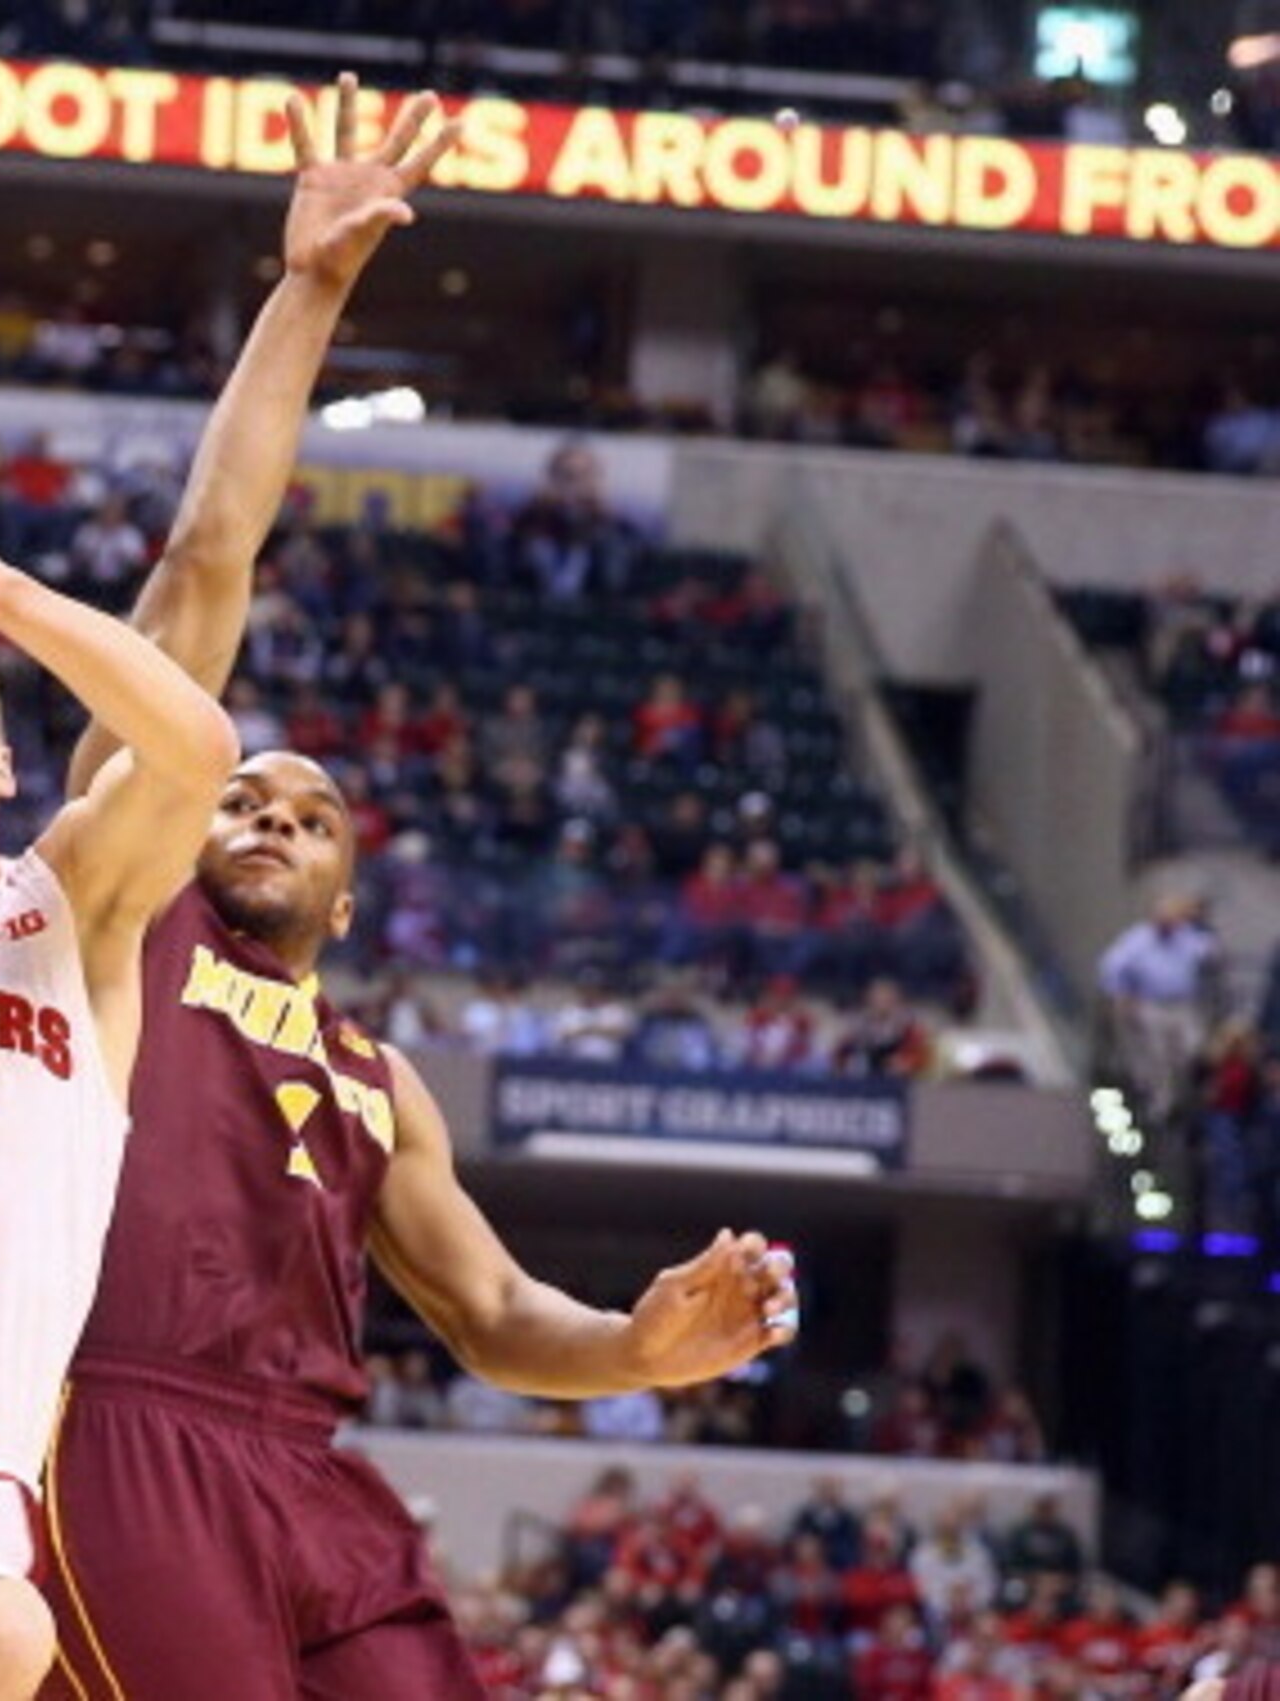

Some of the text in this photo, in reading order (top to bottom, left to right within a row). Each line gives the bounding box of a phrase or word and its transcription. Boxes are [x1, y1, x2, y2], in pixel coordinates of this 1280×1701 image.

[548, 106, 1037, 229] AROUND
[1060, 143, 1280, 248] FRO
[498, 1075, 903, 1147] SPORT GRAPHICS
